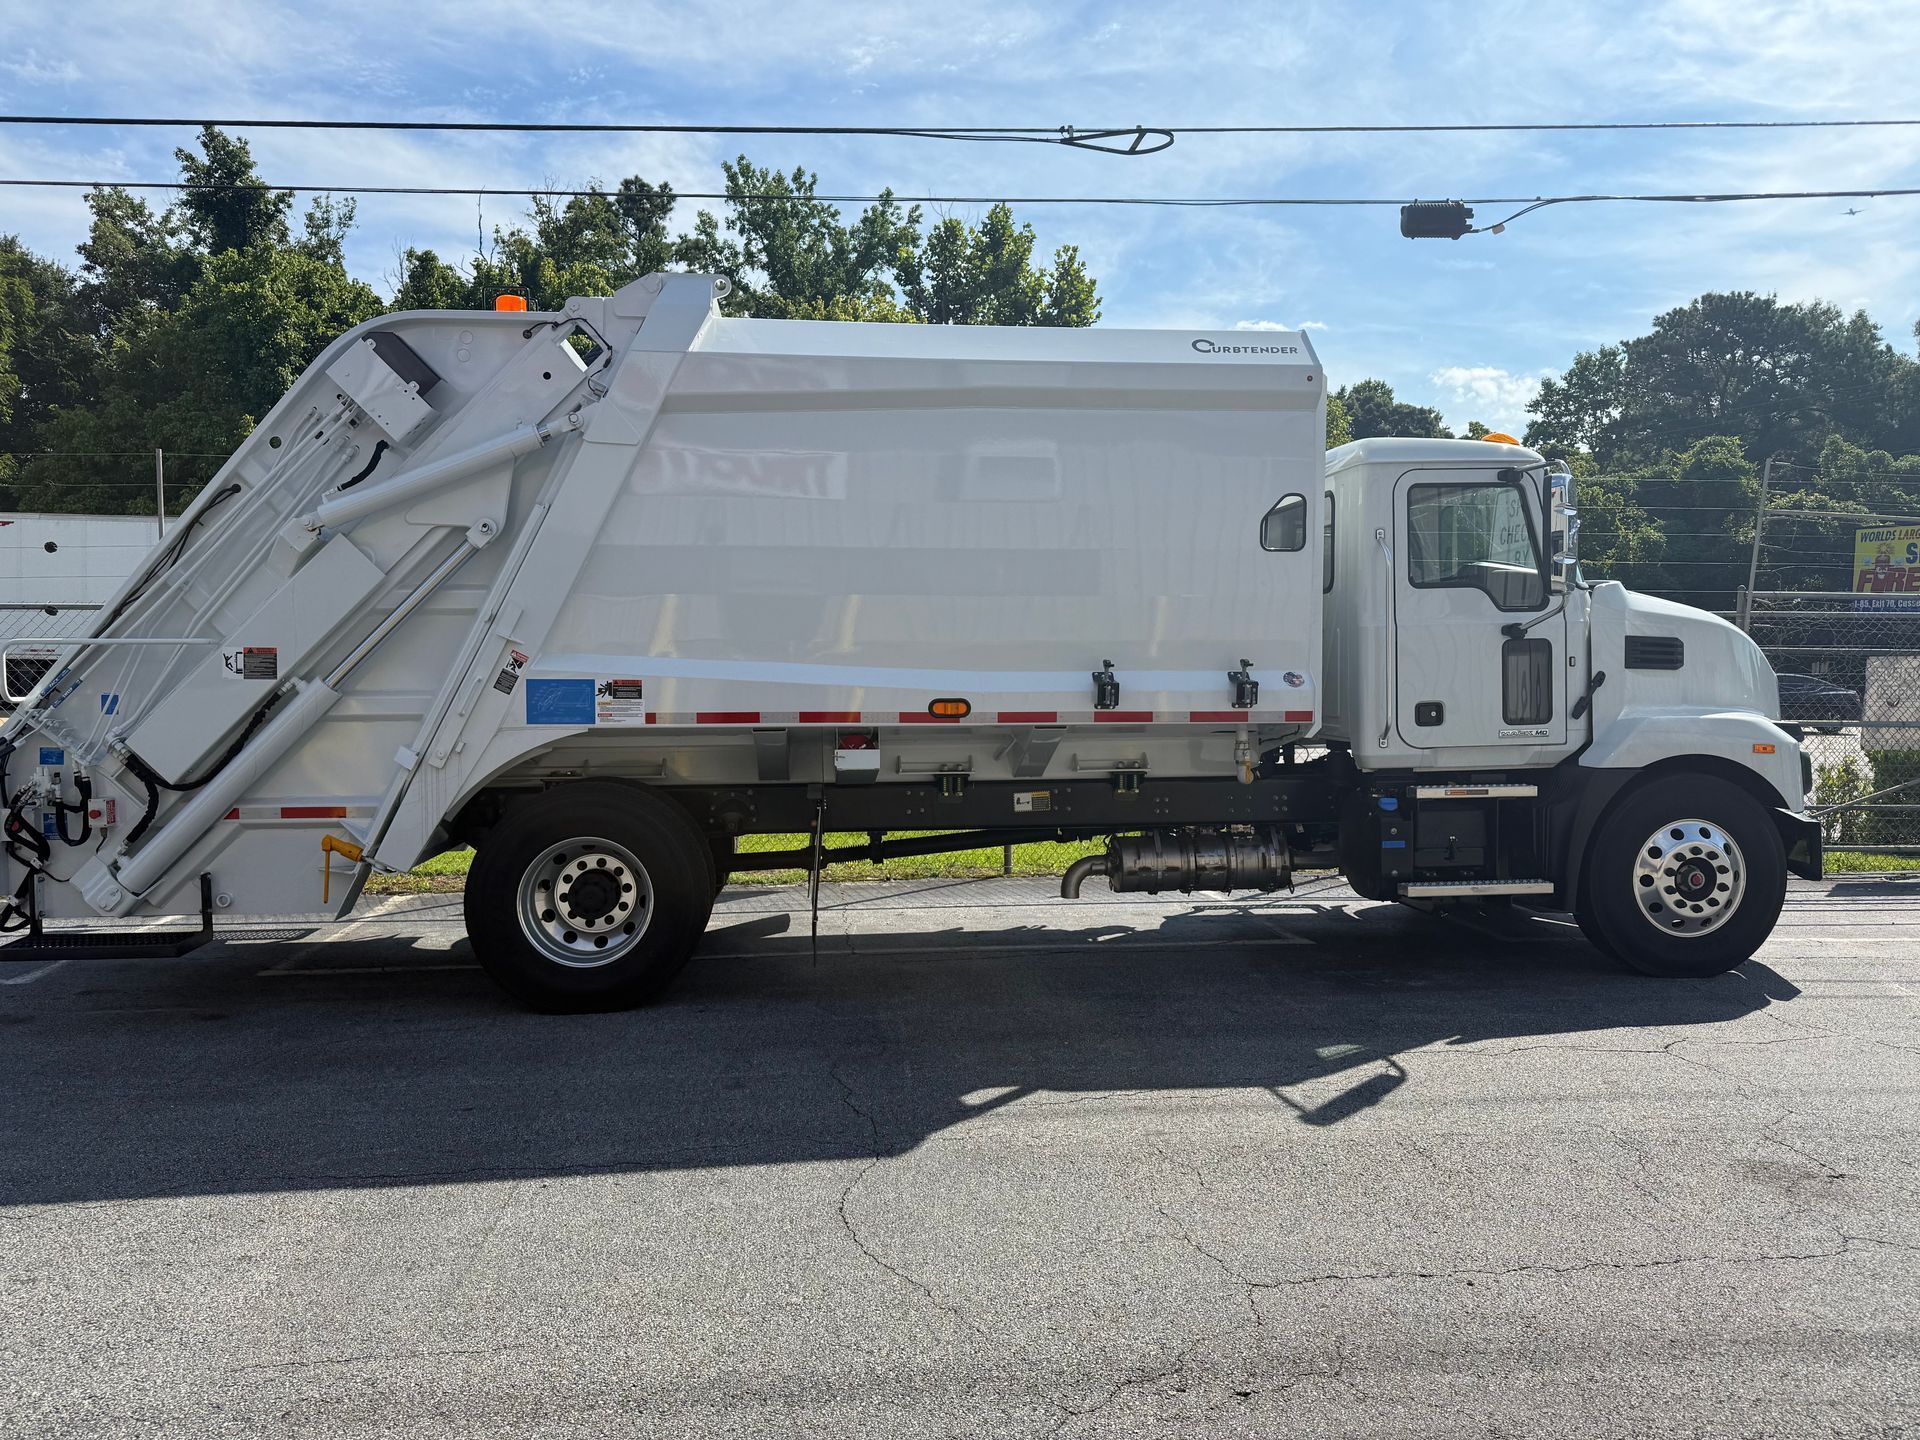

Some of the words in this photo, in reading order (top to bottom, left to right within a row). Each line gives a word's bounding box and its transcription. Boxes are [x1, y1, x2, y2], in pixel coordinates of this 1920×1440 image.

[1191, 338, 1298, 354] CURBTENDER
[1860, 529, 1897, 543] WORLDS
[1905, 542, 1920, 564] S
